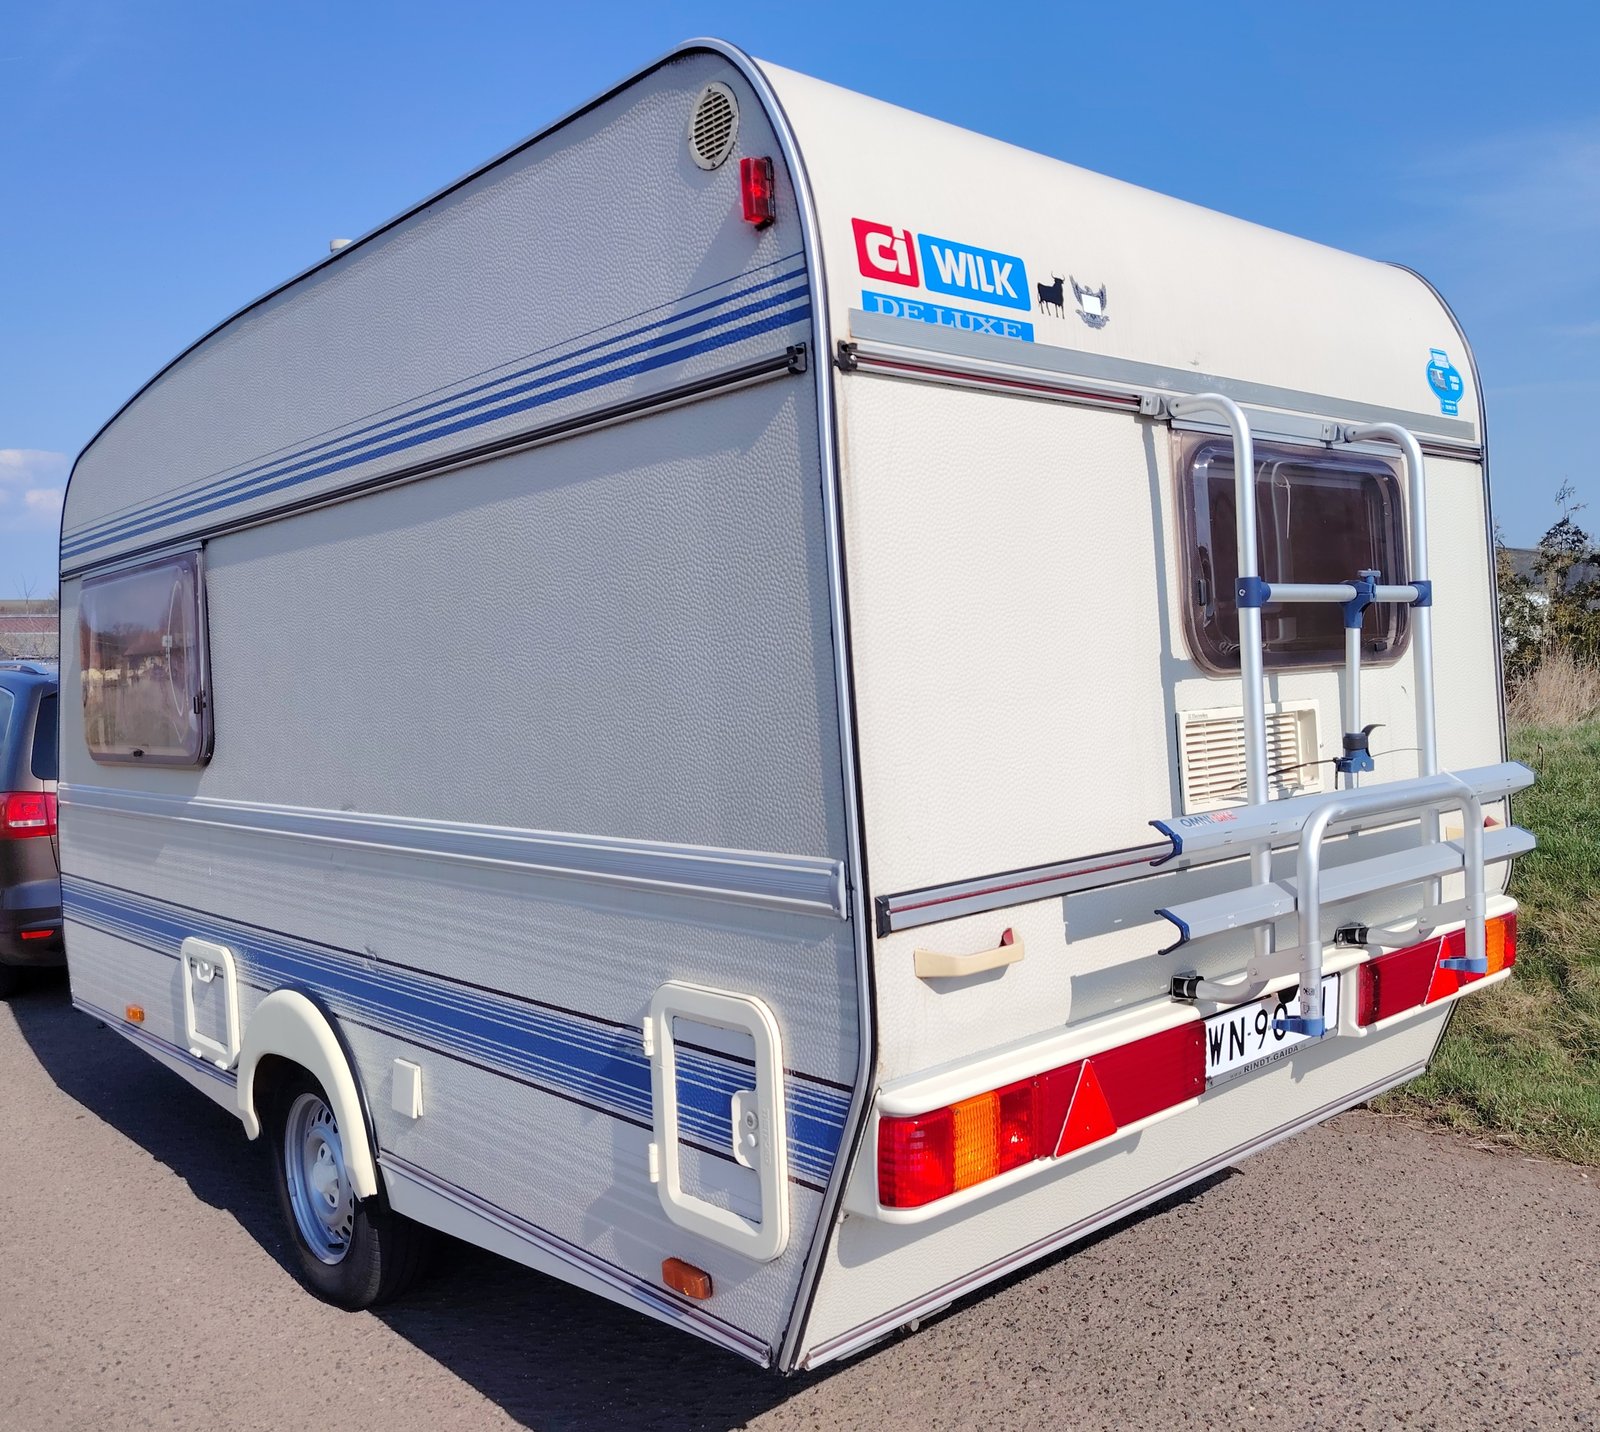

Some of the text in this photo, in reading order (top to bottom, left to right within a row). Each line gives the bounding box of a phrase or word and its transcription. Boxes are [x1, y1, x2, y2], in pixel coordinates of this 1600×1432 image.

[930, 244, 1018, 299] WILK
[873, 295, 1022, 341] DE LUXE
[1243, 1045, 1299, 1073] RINDT-GAIDA
